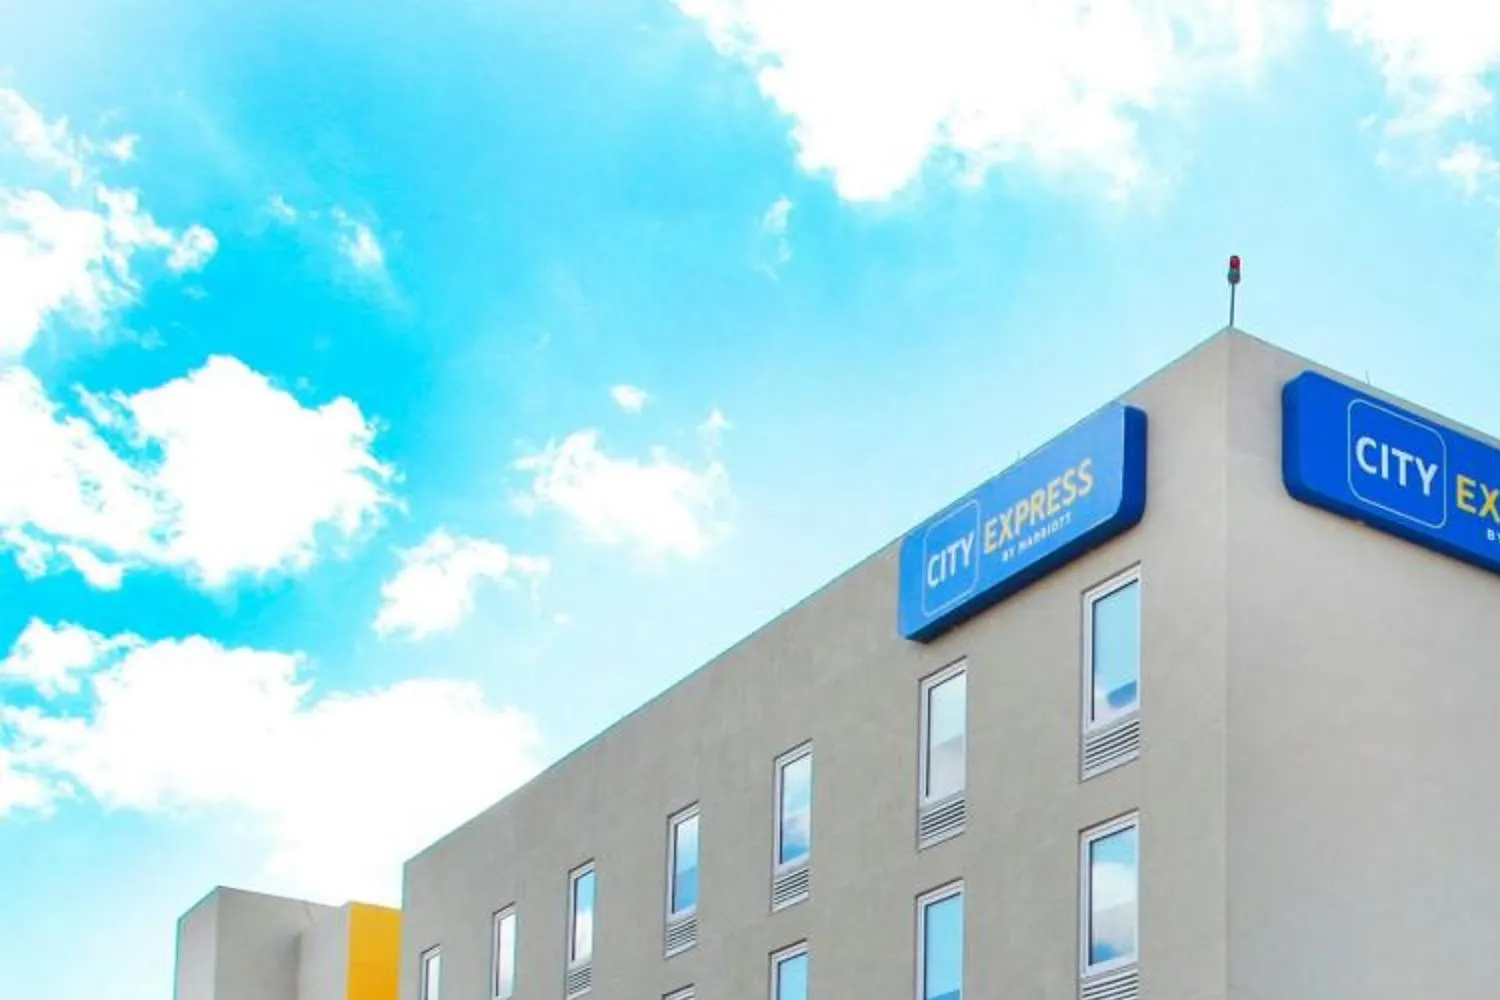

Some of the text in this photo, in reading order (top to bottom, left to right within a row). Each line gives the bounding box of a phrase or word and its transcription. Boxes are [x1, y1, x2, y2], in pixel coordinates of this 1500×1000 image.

[1356, 436, 1439, 497] CITY
[927, 457, 1094, 588] CITY EXPRESS
[1002, 511, 1072, 562] BY MARRIOTT
